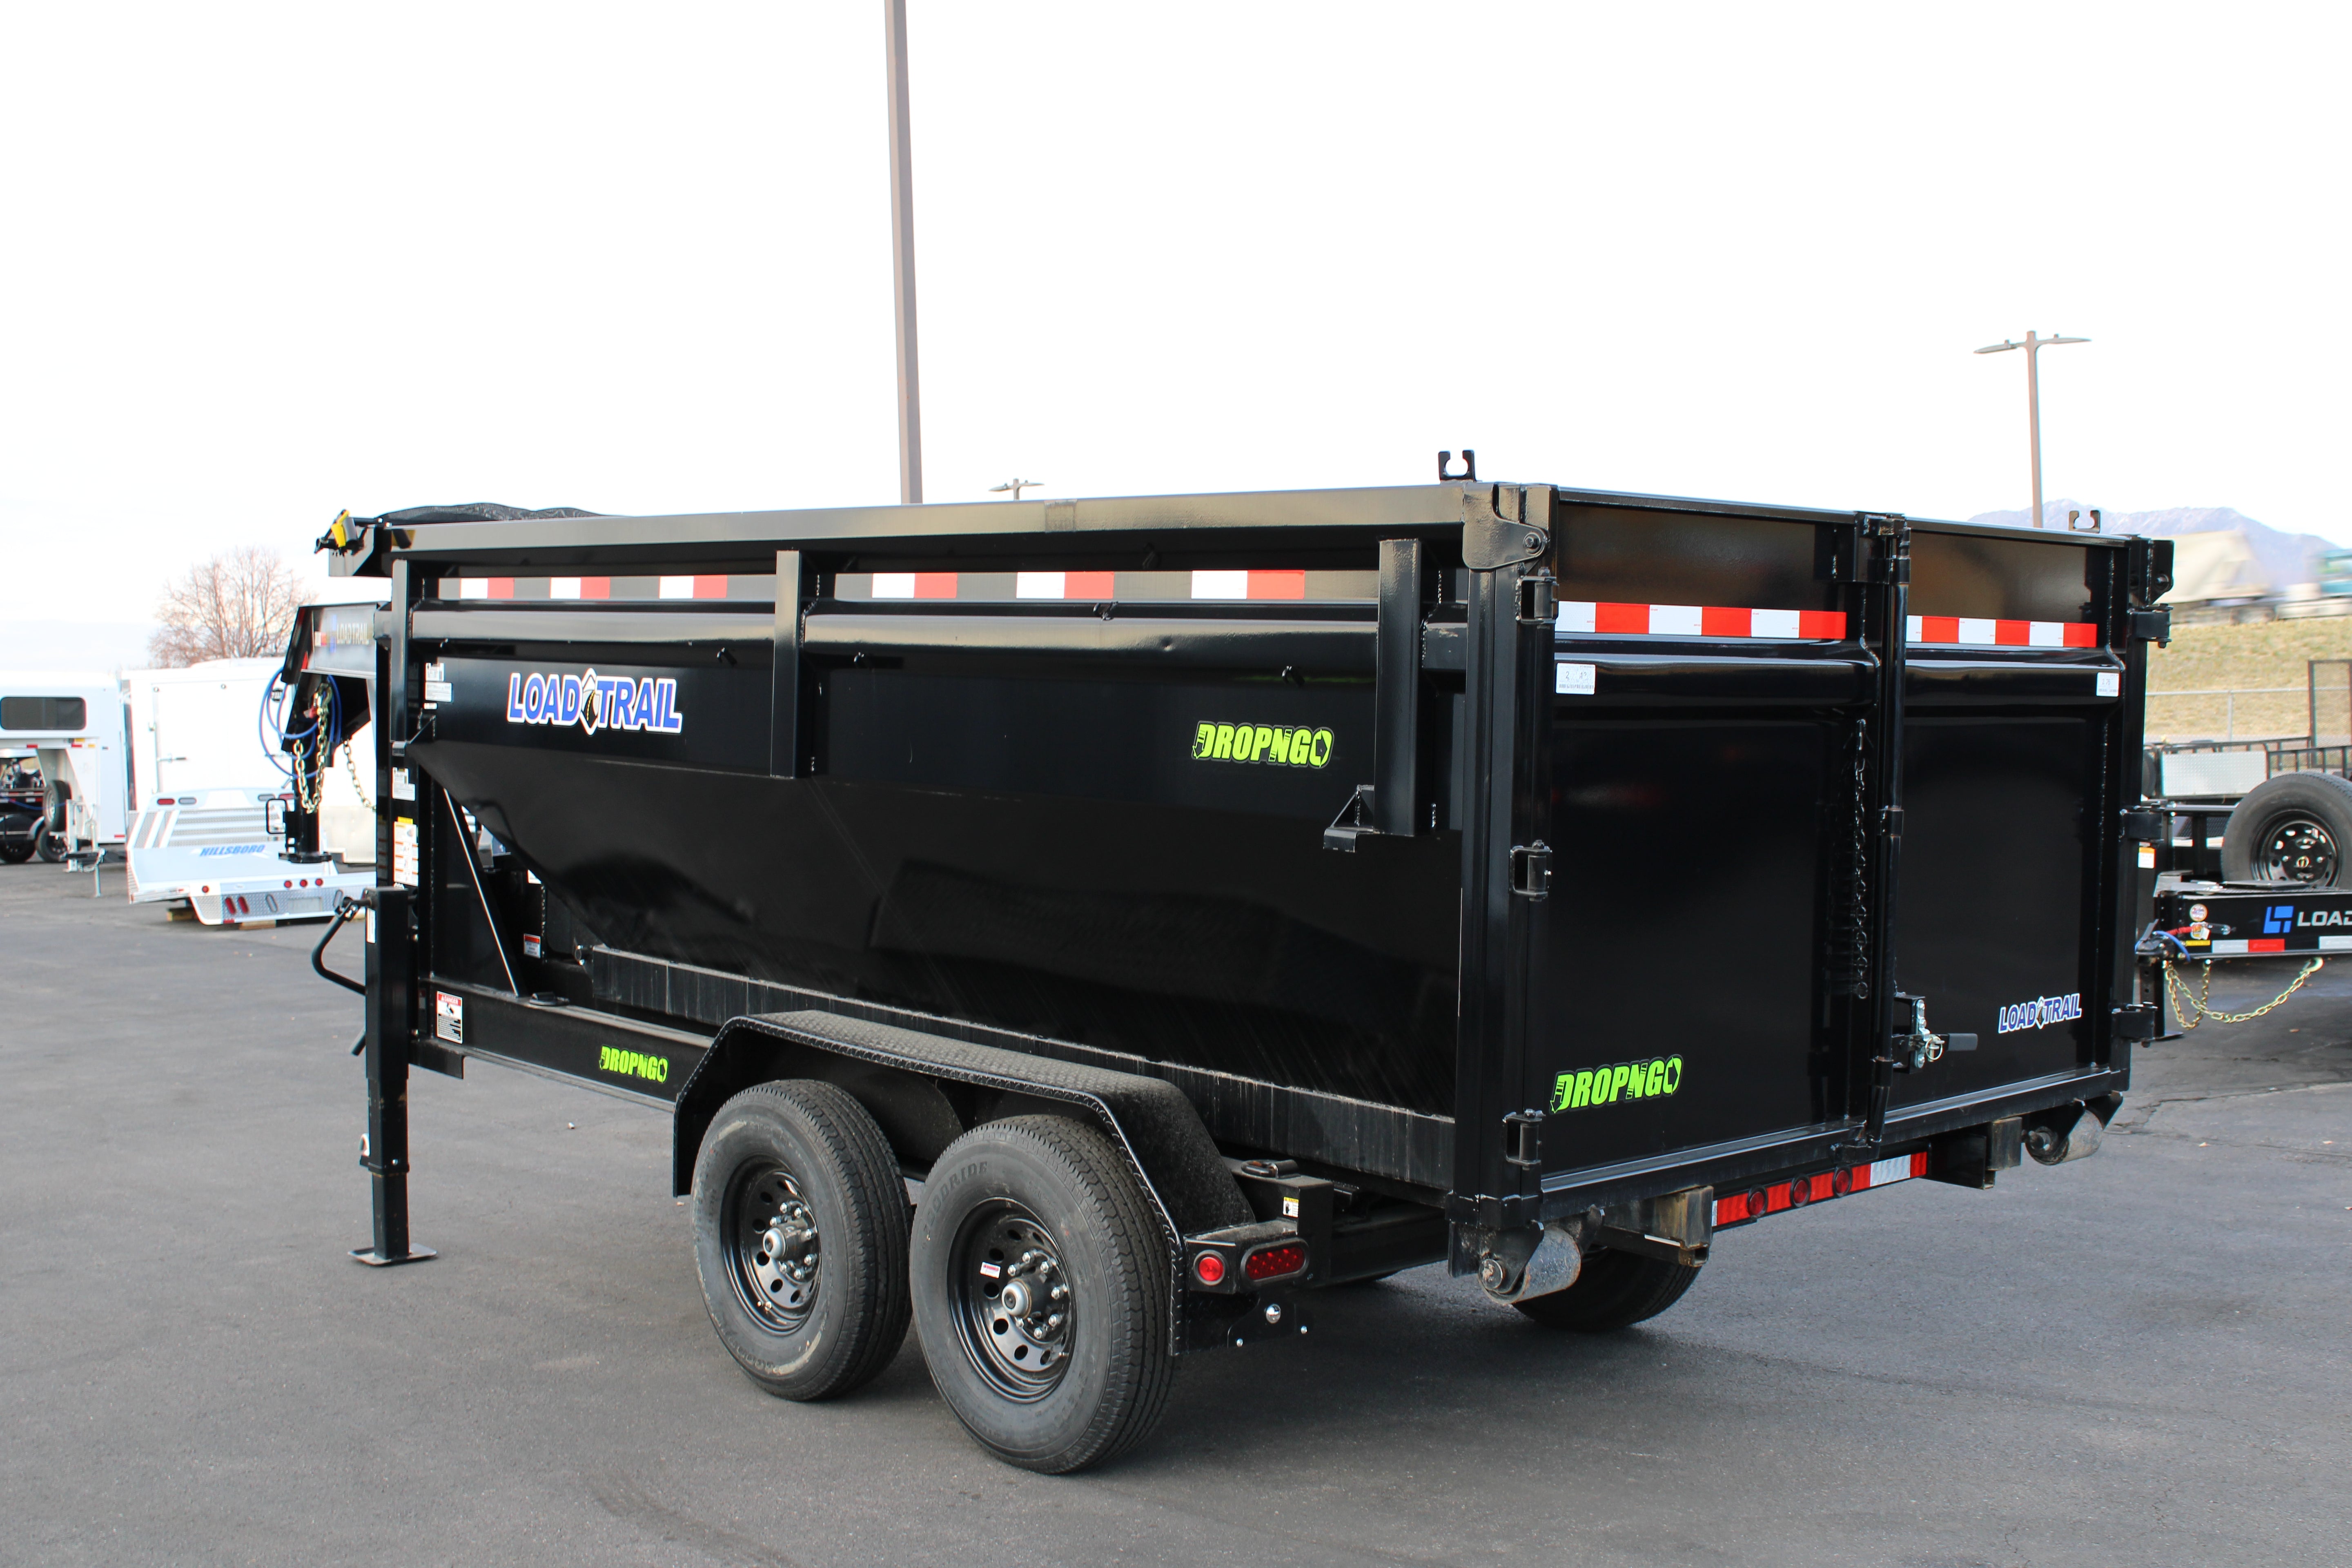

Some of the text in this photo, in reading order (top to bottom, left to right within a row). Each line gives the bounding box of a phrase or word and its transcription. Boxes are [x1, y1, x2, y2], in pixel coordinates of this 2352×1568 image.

[507, 673, 683, 733] LOAD TRAIL
[1192, 724, 1332, 767] DROPNGO
[200, 844, 265, 856] HILLSBORO
[1998, 993, 2082, 1034] LOAD TRAIL
[599, 1046, 668, 1082] DROPNGO
[1550, 1057, 1682, 1113] DROPNGO
